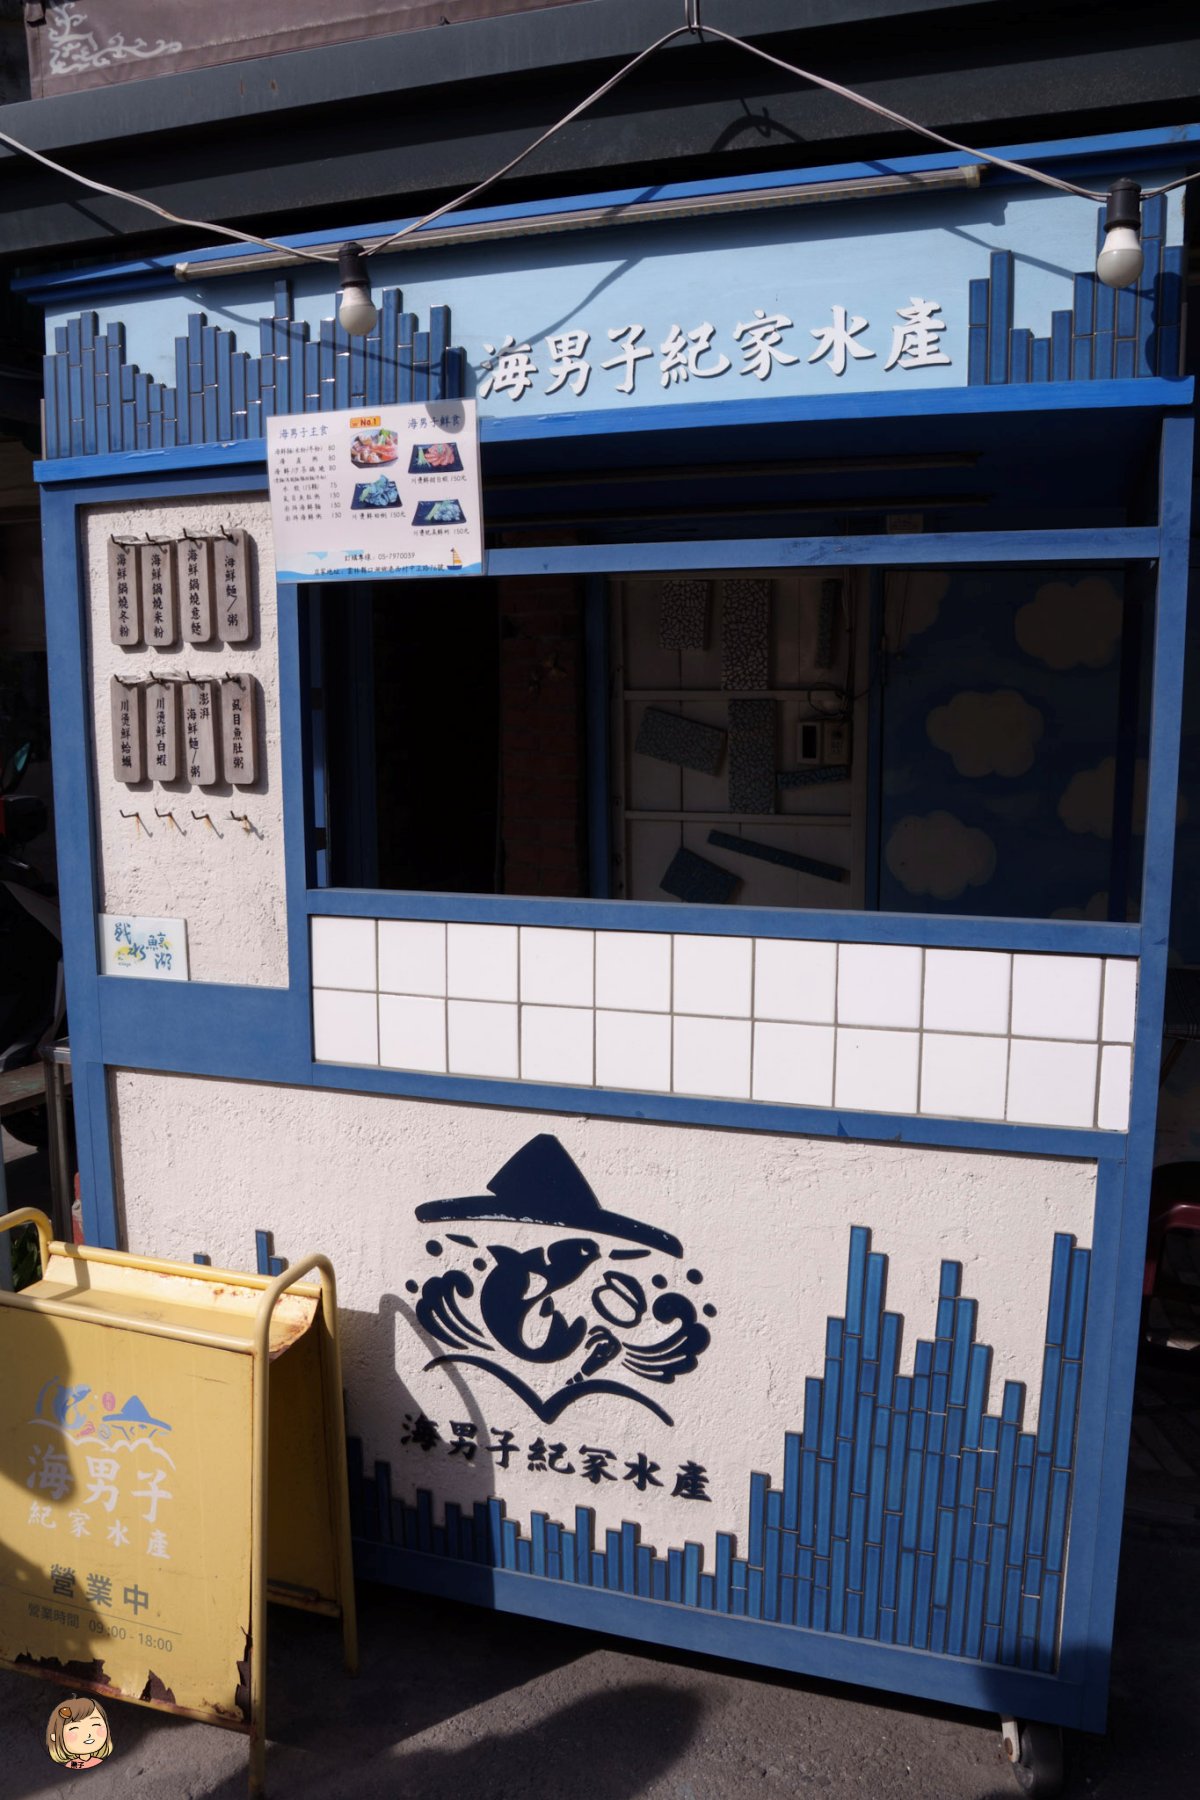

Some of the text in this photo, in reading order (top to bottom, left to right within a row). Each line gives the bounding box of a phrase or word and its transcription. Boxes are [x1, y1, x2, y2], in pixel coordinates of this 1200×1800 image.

[478, 297, 953, 402] 海男子紀家水產
[116, 553, 130, 638] 海鮮鍋燒冬粉
[151, 554, 164, 638] 海鮮鍋燒米粉
[198, 693, 210, 720] 澎湃
[232, 698, 244, 770] 虱目魚肚粥
[26, 1443, 173, 1524] 海男子
[401, 1413, 712, 1502] 海男子紀家水產
[27, 1501, 172, 1560] 紀家水產
[27, 1602, 80, 1629] 營業時間
[88, 1620, 126, 1640] 09:00
[138, 1633, 173, 1653] 18:00
[50, 1564, 149, 1616] 營業中
